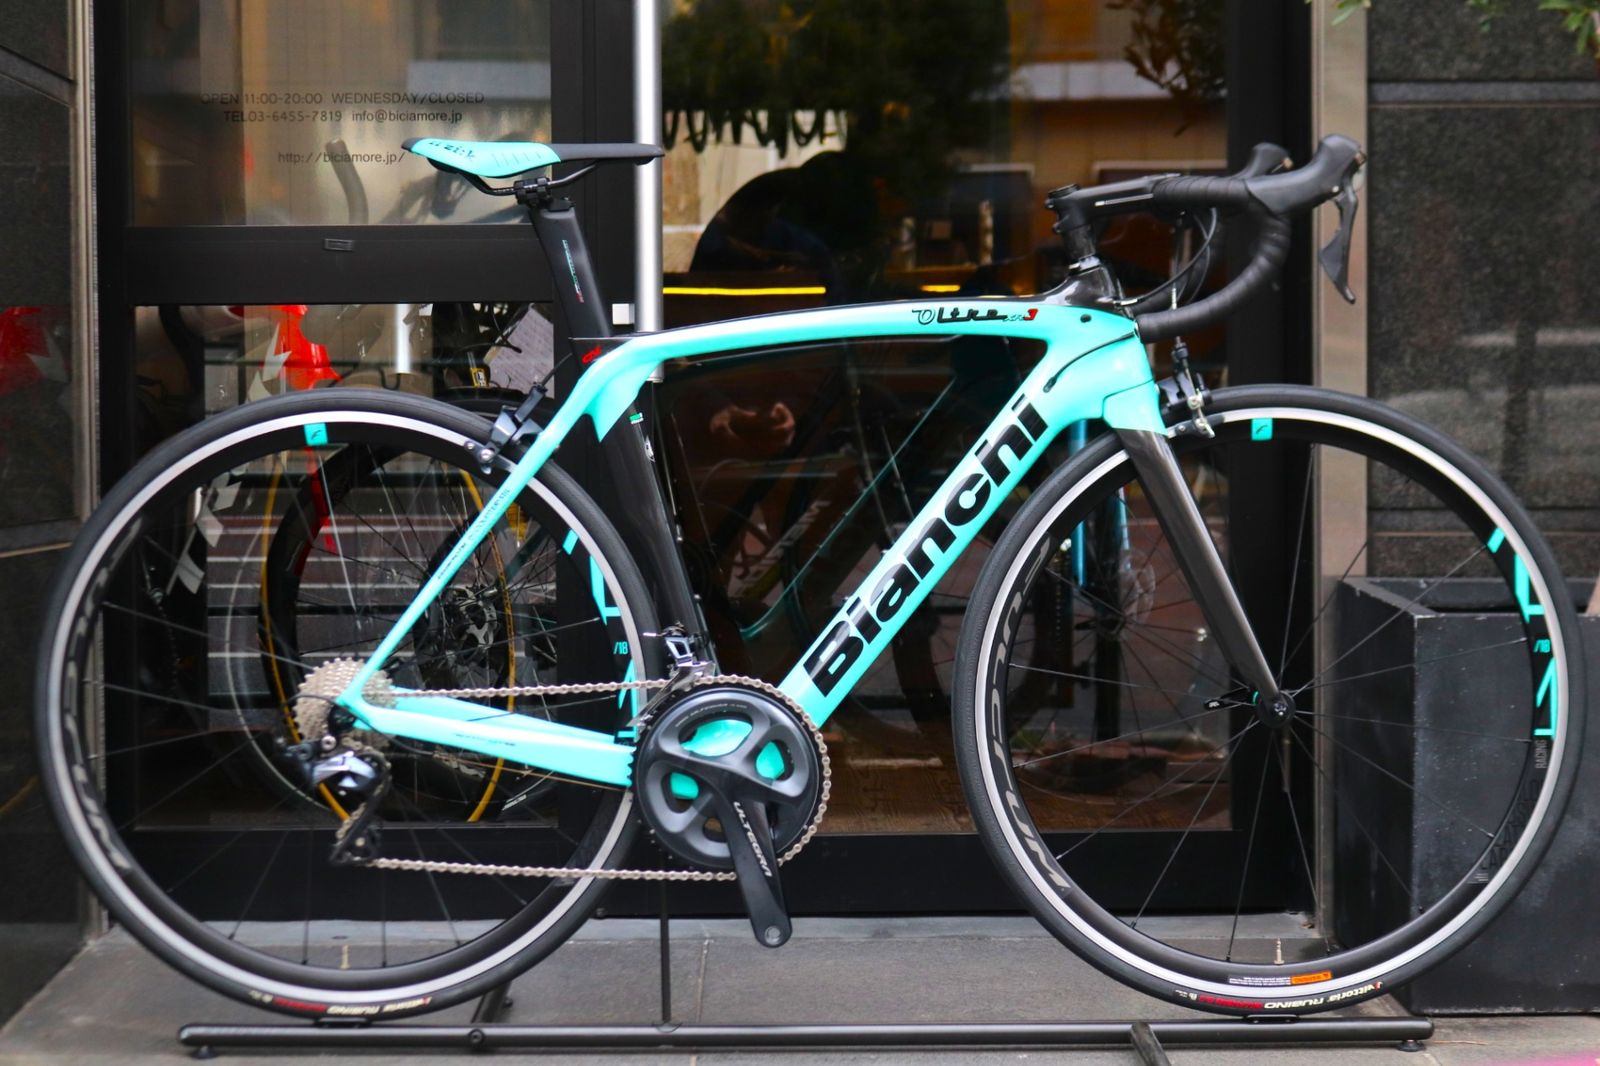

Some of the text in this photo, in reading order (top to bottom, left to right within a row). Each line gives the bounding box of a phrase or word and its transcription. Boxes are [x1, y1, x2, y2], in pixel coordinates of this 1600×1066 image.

[200, 92, 485, 105] OPEN 11:00-20:00 WEDNESDAY/CLOSED
[352, 109, 463, 124] info@biciamore.jp
[277, 151, 406, 166] http://biciamore.jp/
[802, 393, 1048, 698] Bianchi
[991, 535, 1071, 889] FULCRUM
[732, 800, 774, 878] ULTEGRA
[1326, 983, 1376, 1004] vittoria
[1263, 997, 1325, 1010] RUBINO
